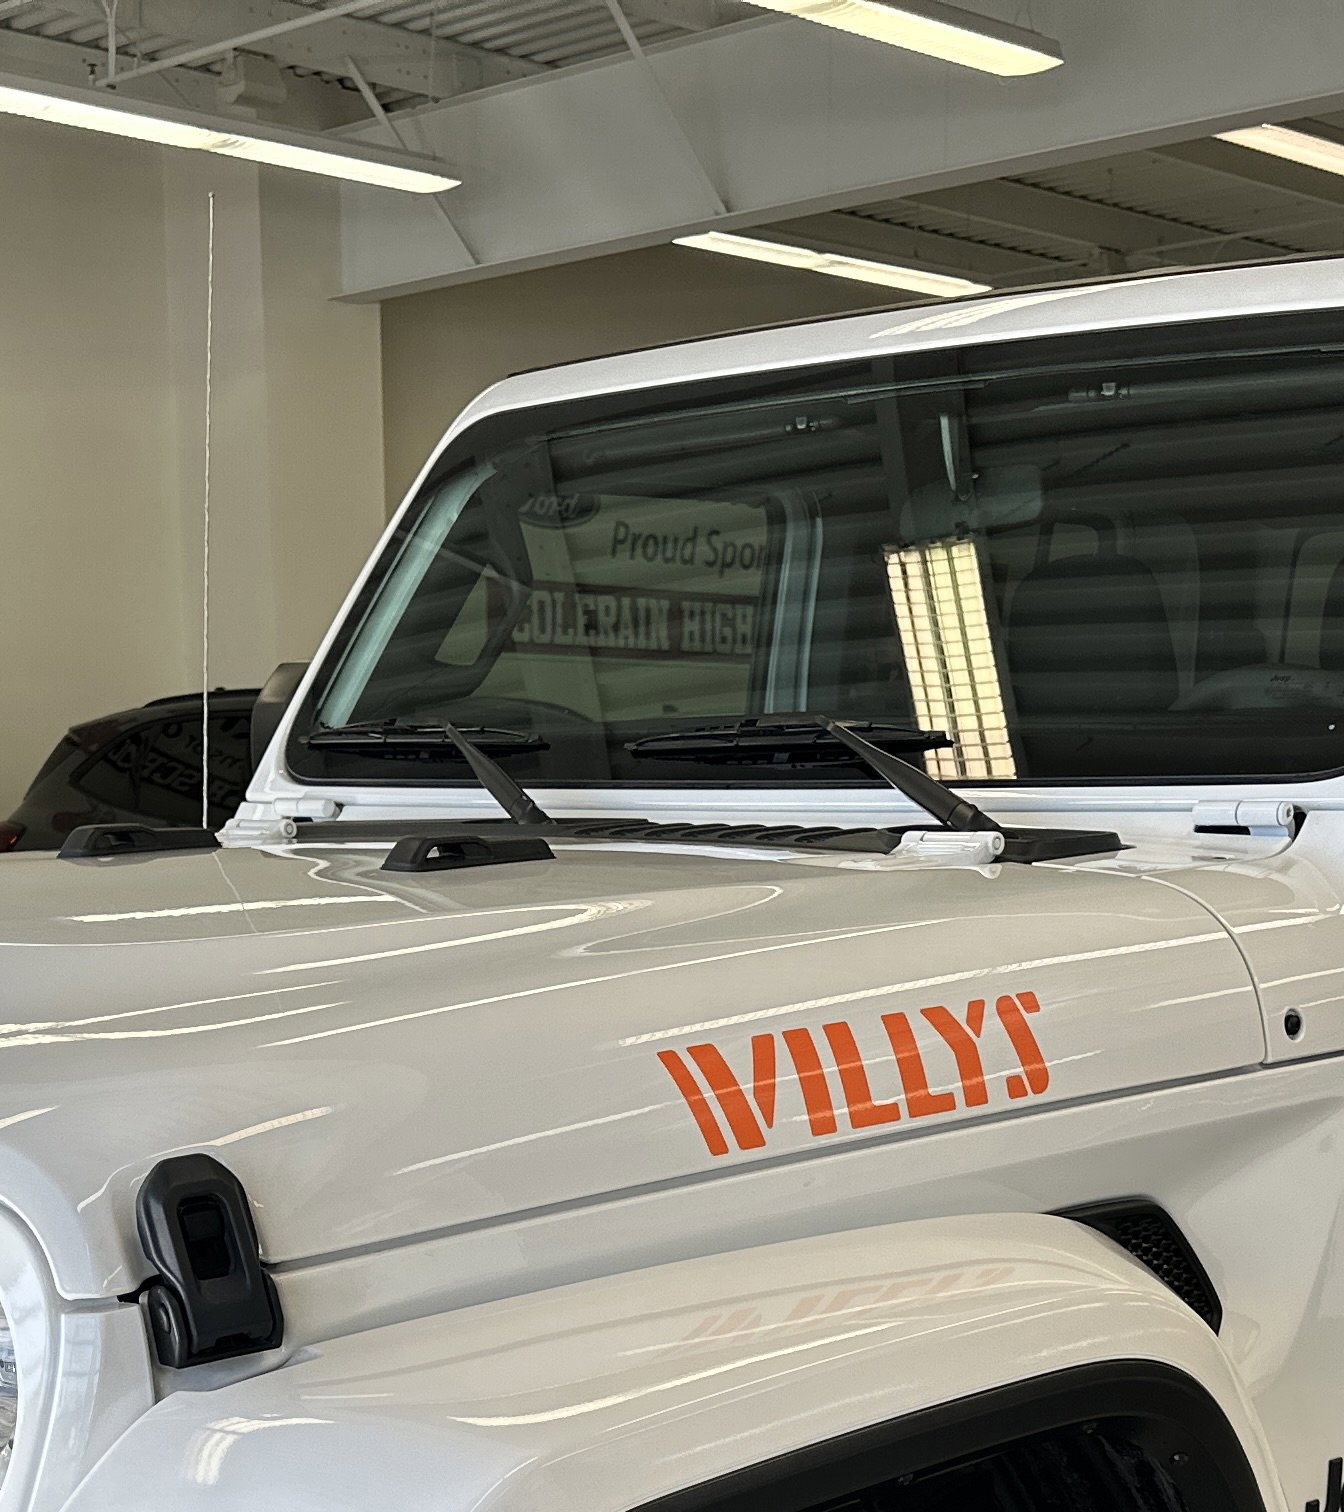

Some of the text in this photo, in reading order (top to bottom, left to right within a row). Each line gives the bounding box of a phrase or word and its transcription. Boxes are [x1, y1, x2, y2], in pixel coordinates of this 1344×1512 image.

[610, 520, 699, 566] Proud
[680, 601, 754, 654] HIGH
[656, 991, 1050, 1156] WILLYS
